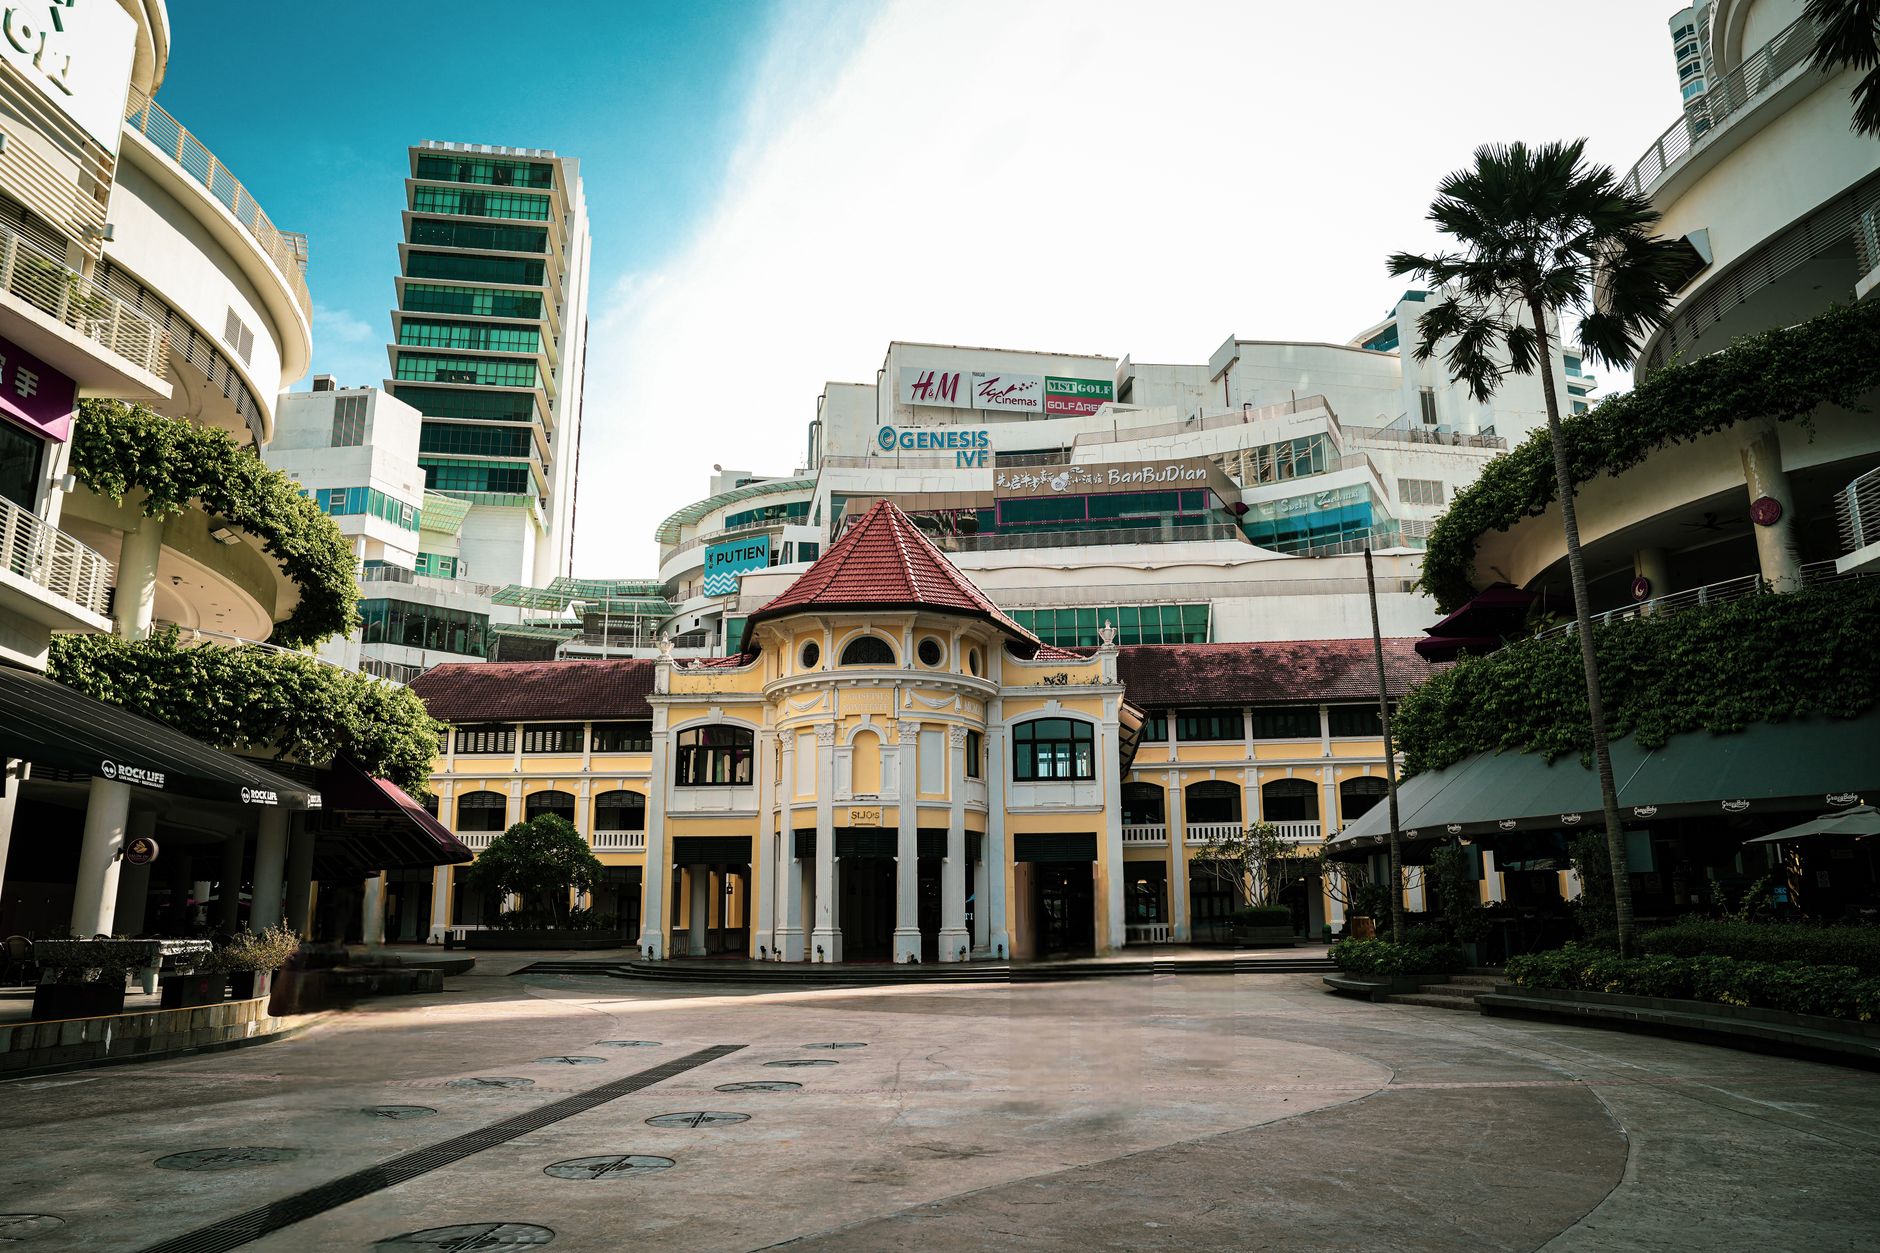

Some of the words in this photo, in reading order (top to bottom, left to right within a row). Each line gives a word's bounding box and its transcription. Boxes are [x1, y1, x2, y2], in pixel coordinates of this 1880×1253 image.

[911, 370, 960, 403] H&M
[1048, 381, 1076, 392] MST
[1077, 384, 1112, 395] GOLF
[994, 395, 1038, 407] Cinemas
[899, 430, 989, 449] GENESIS
[956, 449, 989, 469] IVF
[716, 544, 765, 566] PUTIEN
[118, 764, 146, 780] ROCK
[146, 770, 165, 784] LIFE
[250, 789, 267, 799] ROCK
[267, 791, 278, 800] LIFE
